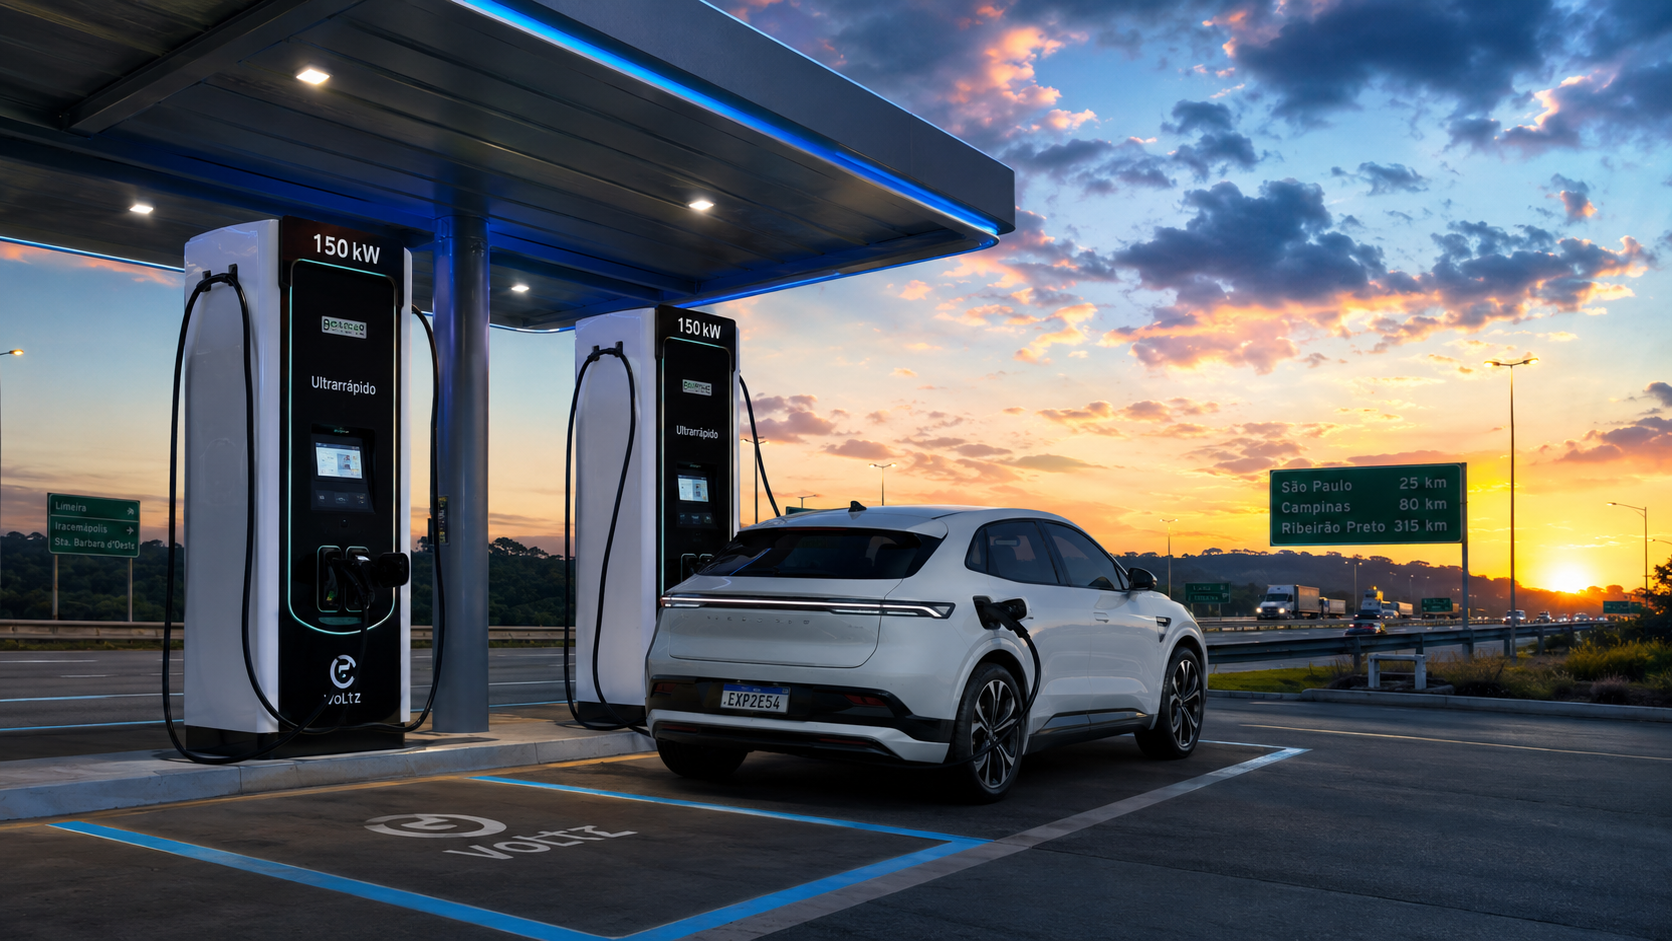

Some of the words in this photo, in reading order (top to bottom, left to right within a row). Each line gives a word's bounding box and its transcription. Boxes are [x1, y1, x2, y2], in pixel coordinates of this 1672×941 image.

[313, 233, 349, 259] 150
[352, 241, 380, 265] kW
[678, 317, 701, 336] 150
[702, 322, 721, 339] kW
[311, 375, 376, 396] Ultrarrápido
[676, 425, 719, 440] Ultrarrápido
[1281, 480, 1307, 494] São
[1313, 480, 1352, 493] Paulo
[1399, 477, 1419, 490] 25
[1425, 476, 1447, 489] km
[1281, 501, 1351, 515] Campinas
[1399, 498, 1419, 511] 80
[1425, 498, 1447, 510] km
[1281, 521, 1341, 534] Ribeirão
[1346, 520, 1386, 533] Preto
[1394, 519, 1419, 532] 315
[1425, 518, 1447, 531] km
[727, 692, 780, 710] EXP2E54
